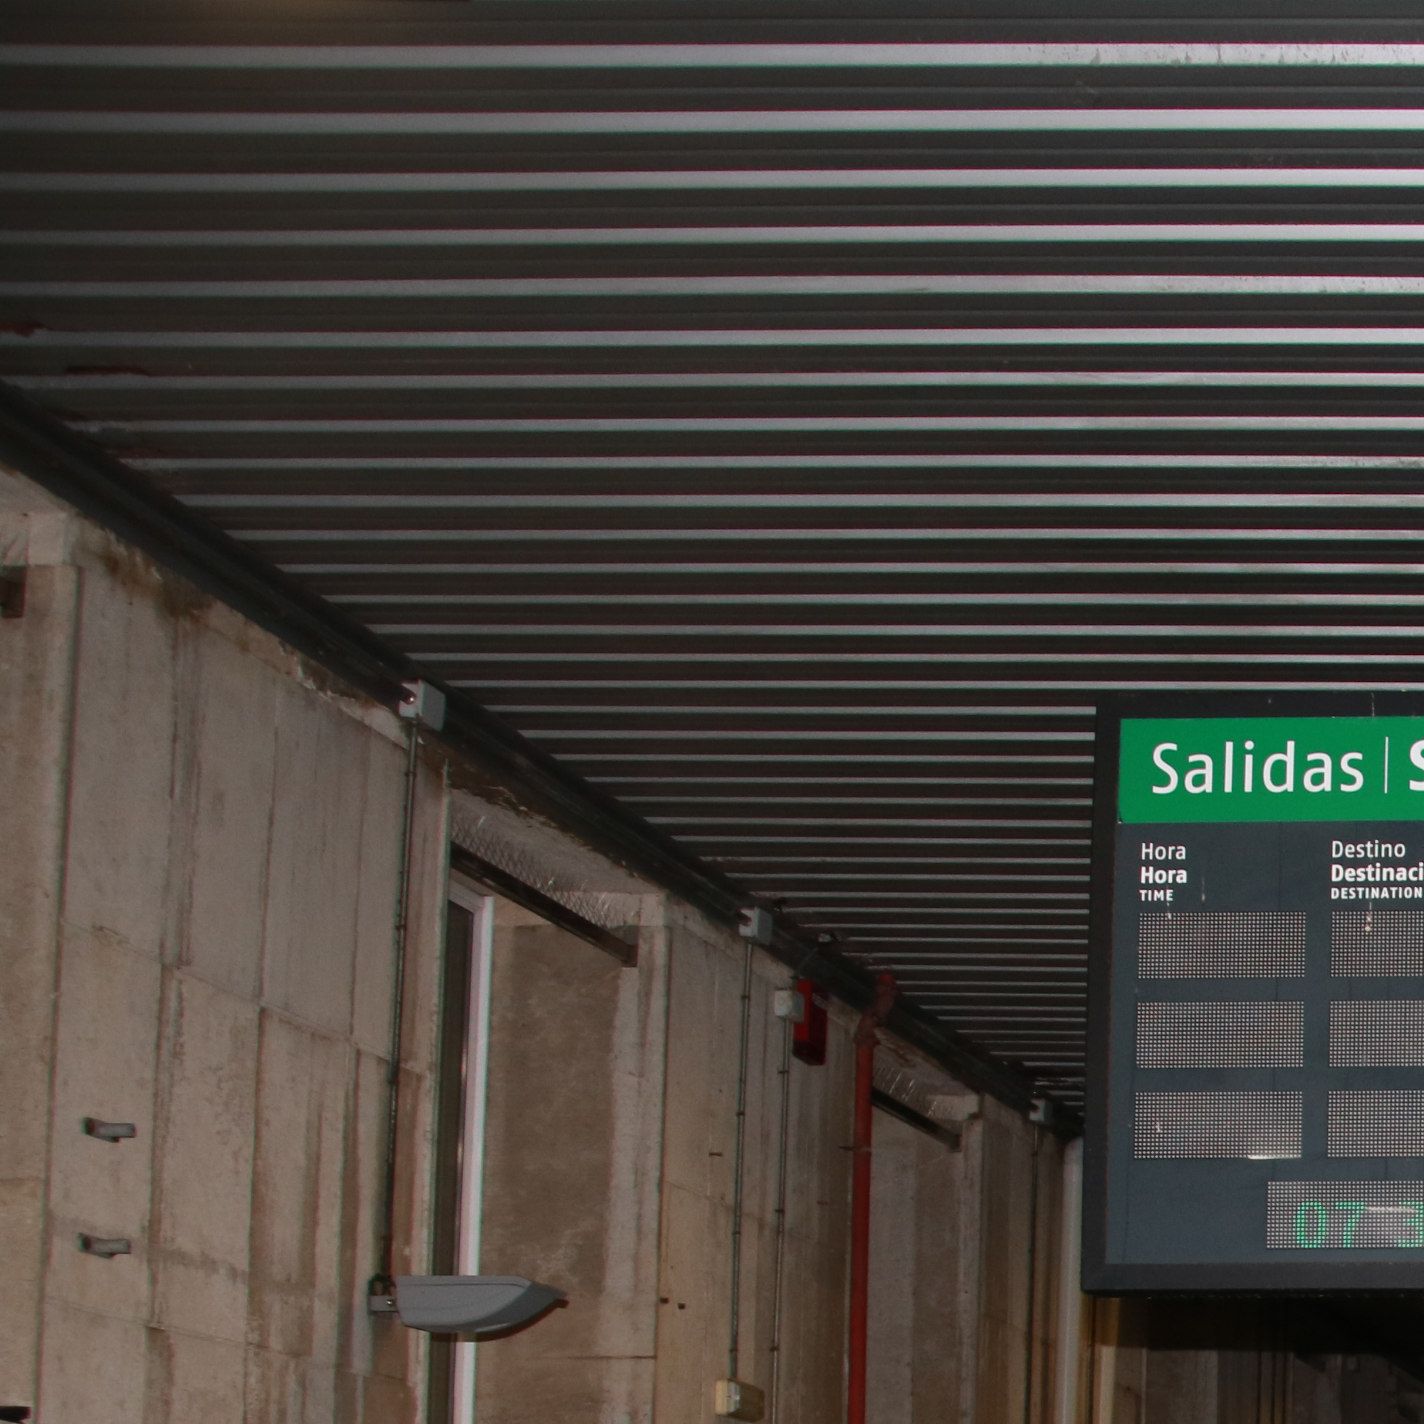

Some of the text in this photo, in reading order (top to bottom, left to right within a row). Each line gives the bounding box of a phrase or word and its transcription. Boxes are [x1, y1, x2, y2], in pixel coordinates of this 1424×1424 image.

[1153, 741, 1363, 793] Salidas
[1142, 843, 1185, 860] Hora
[1332, 840, 1405, 858] Destino
[1141, 866, 1187, 884] Hora
[1140, 889, 1173, 901] TIME
[1331, 887, 1422, 899] DESTINATION
